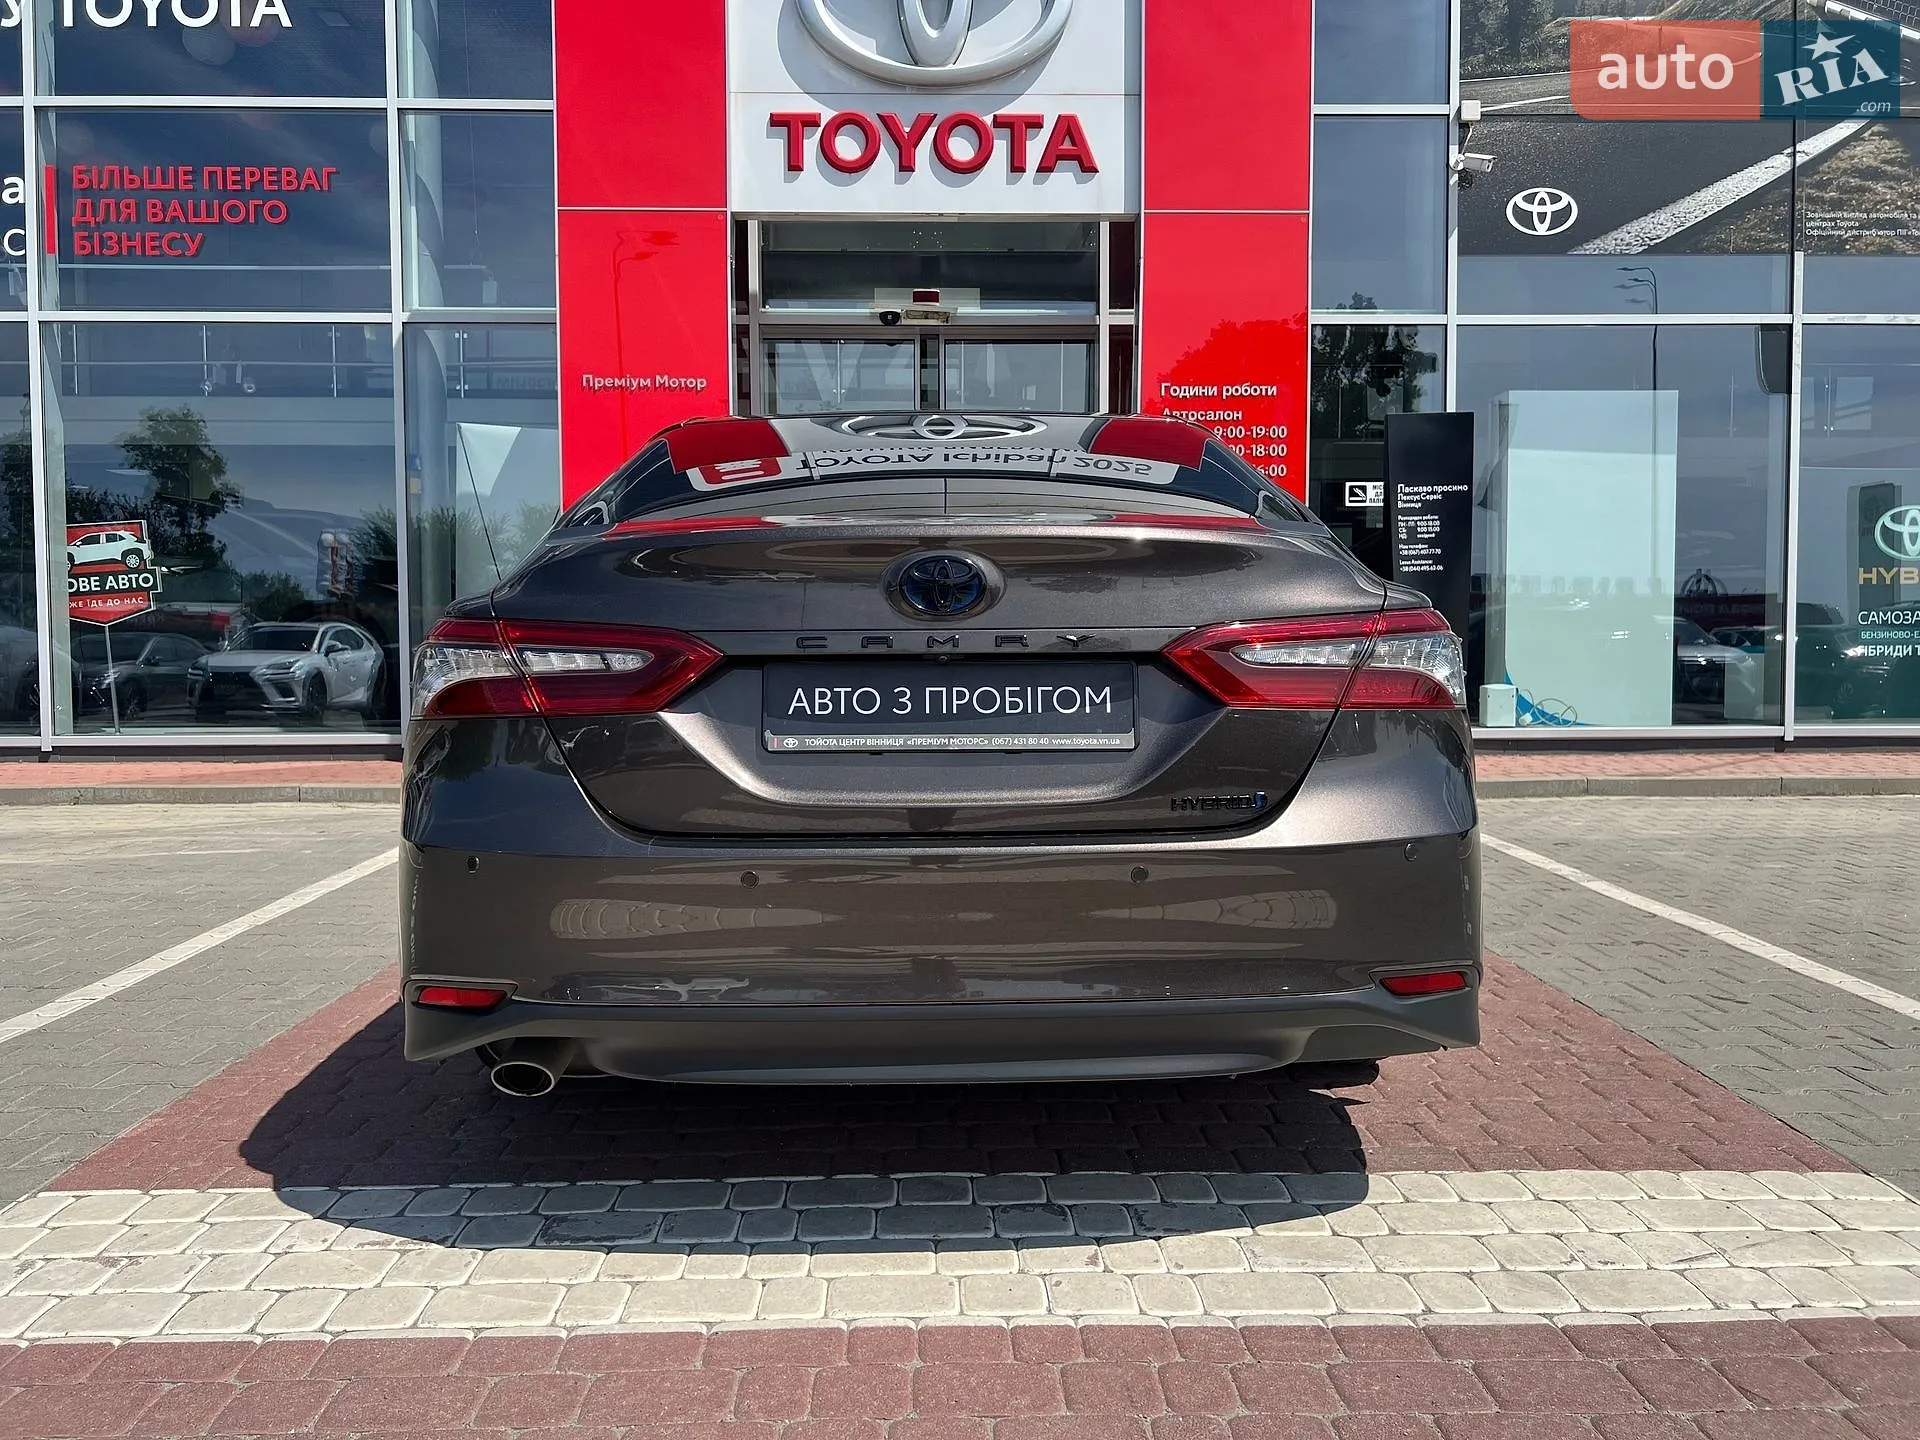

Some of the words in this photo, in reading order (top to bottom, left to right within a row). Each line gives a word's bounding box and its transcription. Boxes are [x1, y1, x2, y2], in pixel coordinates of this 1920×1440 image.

[62, 0, 293, 28] TOYOTA
[769, 110, 1099, 174] TOYOTA
[72, 165, 194, 190] БІЛЬШЕ
[203, 166, 337, 191] ПЕРЕВАГ
[71, 198, 137, 227] ДЛЯ
[146, 199, 288, 225] ВАШОГО
[72, 231, 204, 257] БІЗНЕСУ
[582, 374, 651, 390] Преміум
[655, 374, 707, 390] Мотор
[1160, 382, 1218, 398] Години
[1222, 382, 1277, 399] роботи
[1163, 408, 1242, 421] Автосалон
[105, 573, 154, 590] АВТО
[106, 598, 121, 607] ДО
[124, 596, 144, 604] НАС
[796, 632, 1097, 649] CAMRY
[787, 686, 881, 715] АВТО
[925, 686, 1112, 714] ПРОБІГОМ
[804, 737, 838, 746] ТОЙОТА
[839, 737, 865, 747] ЦЕНТР
[866, 737, 904, 747] ВІННИЦЯ
[907, 737, 948, 746] «ПРЕМІУМ
[950, 737, 988, 746] МОТОРС»
[991, 737, 1012, 746] (067)
[1013, 737, 1026, 745] 431
[1028, 737, 1038, 745] 80
[1039, 737, 1049, 745] 40
[1051, 737, 1120, 746] www.toyota.vn.ua
[1170, 794, 1253, 811] HYBRID
